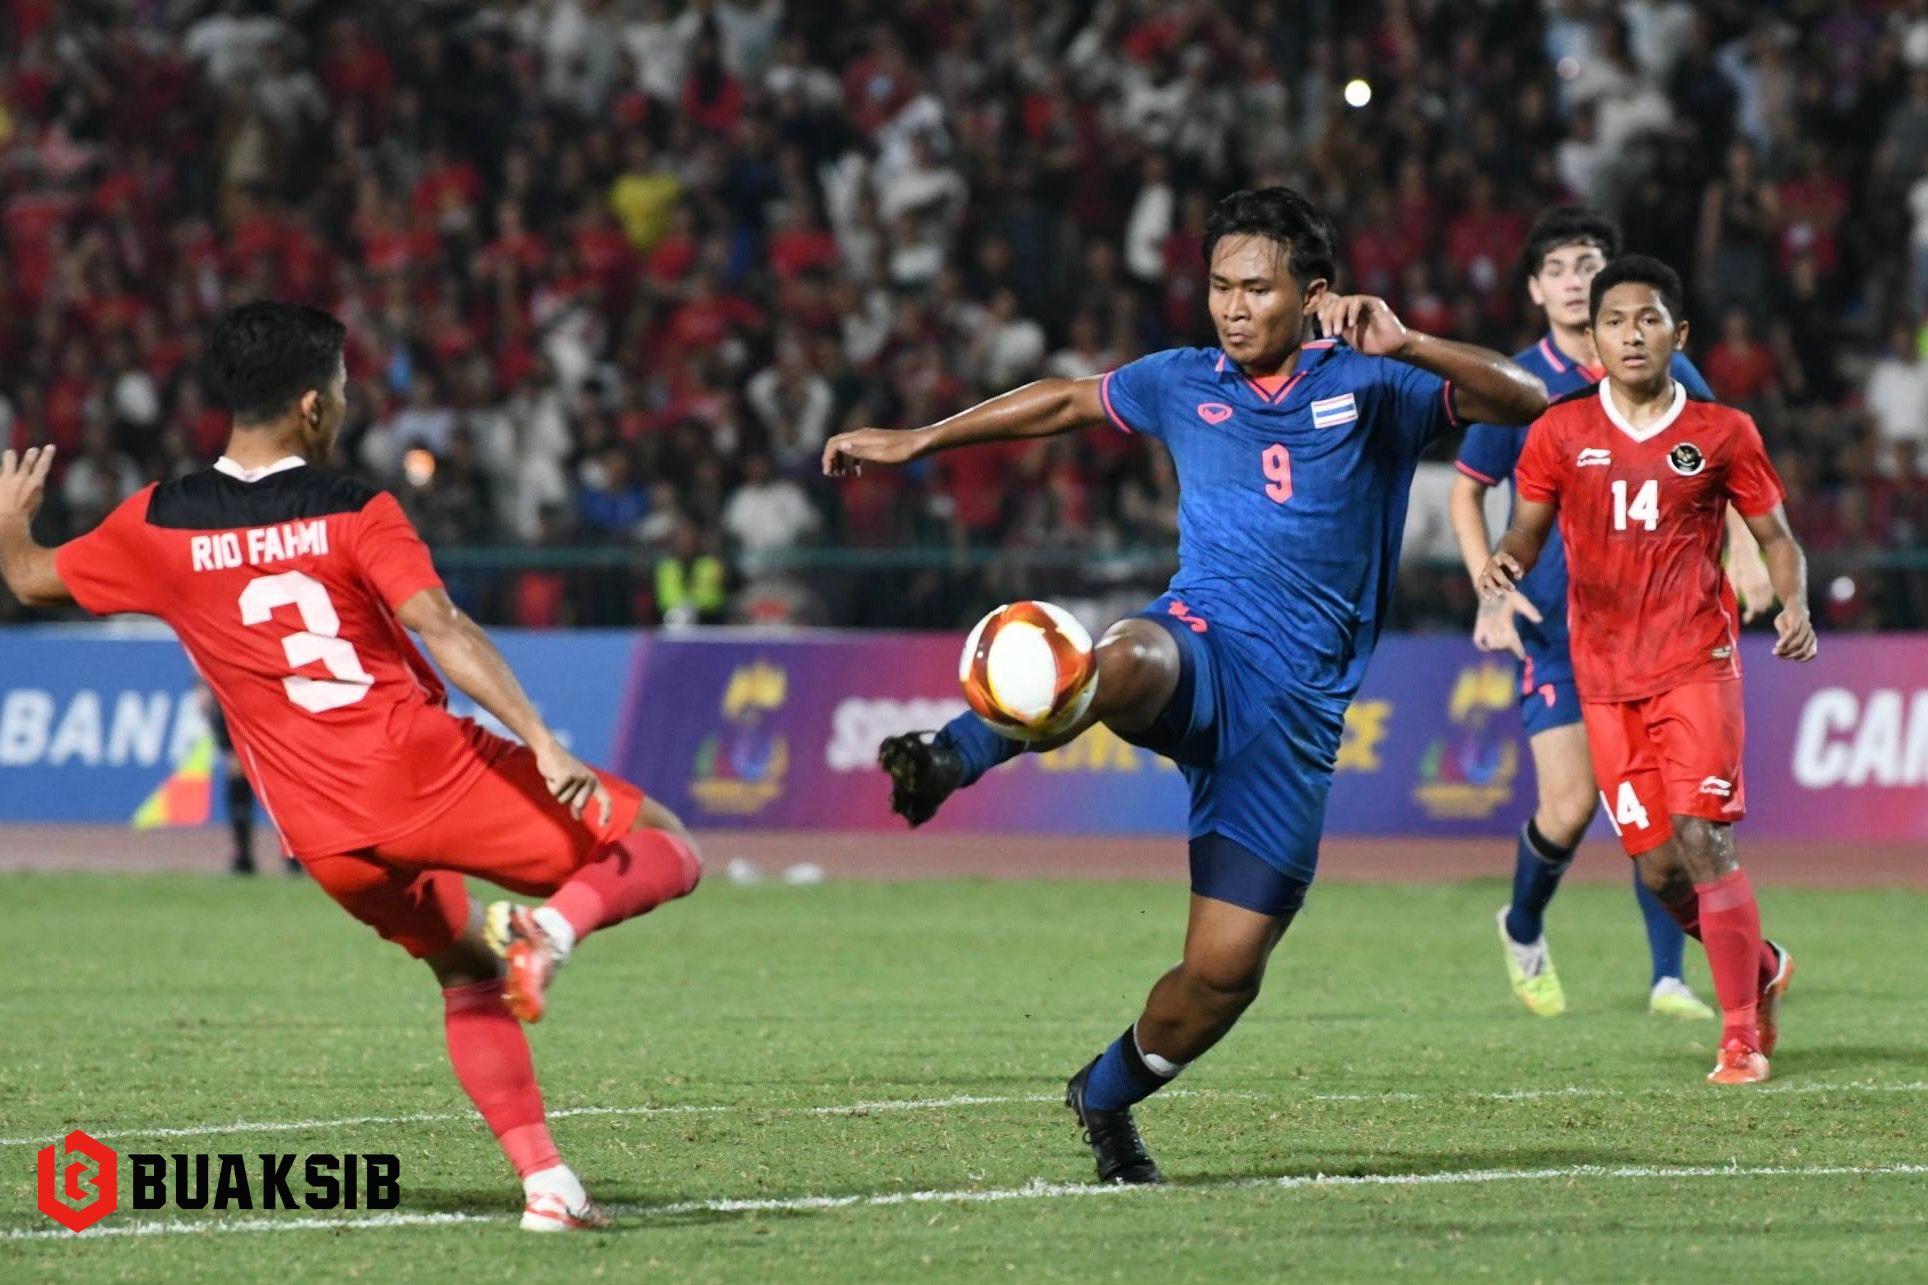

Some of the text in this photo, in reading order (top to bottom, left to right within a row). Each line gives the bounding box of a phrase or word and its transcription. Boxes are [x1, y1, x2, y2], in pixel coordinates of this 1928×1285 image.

[1262, 443, 1293, 504] 9
[1611, 479, 1659, 531] 14
[191, 519, 329, 572] RIO FAHMI
[238, 570, 375, 713] 3
